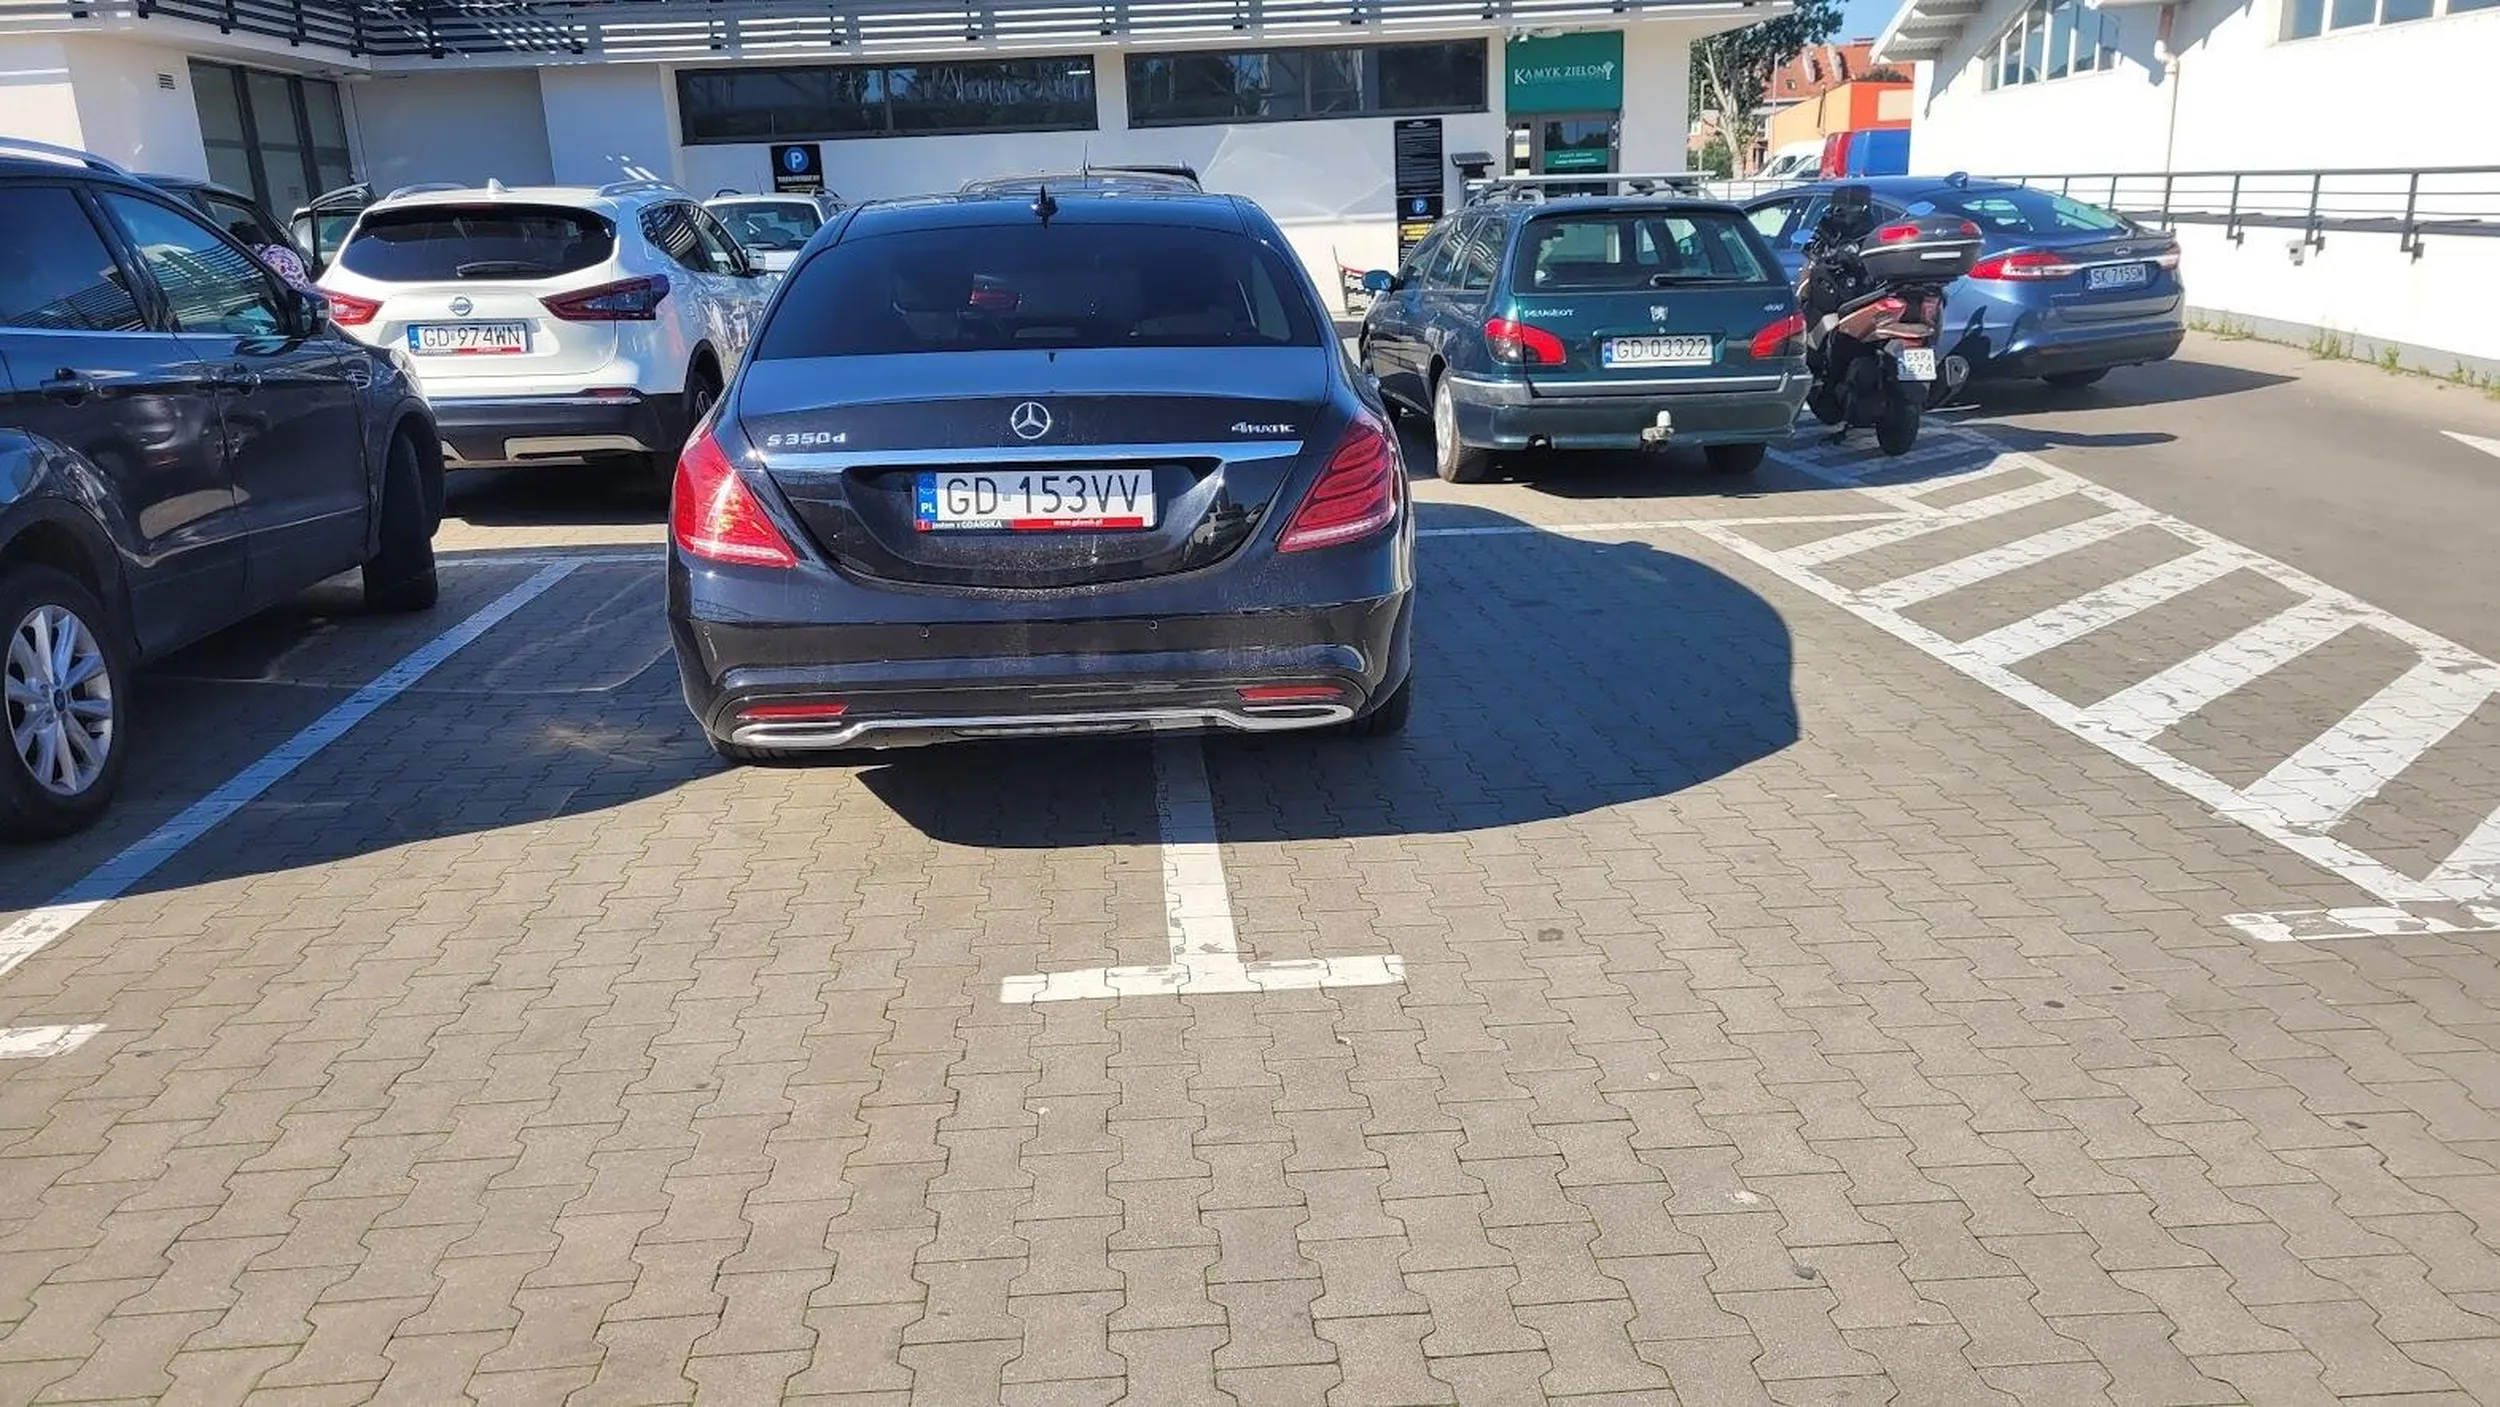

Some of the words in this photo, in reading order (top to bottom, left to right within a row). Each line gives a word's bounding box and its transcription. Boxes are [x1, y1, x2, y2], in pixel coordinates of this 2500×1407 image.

[1514, 67, 1561, 85] KAMYK
[1564, 61, 1615, 80] ZIELONY
[790, 152, 803, 169] P
[2093, 268, 2109, 284] SK
[423, 327, 449, 347] GD
[457, 326, 520, 346] 974WN
[1616, 339, 1643, 359] GD
[1651, 338, 1707, 358] 03322
[1231, 421, 1296, 434] 4MATIC
[766, 433, 782, 447] S
[946, 476, 998, 516] GD
[1018, 474, 1141, 515] 153VV
[920, 502, 936, 514] PL
